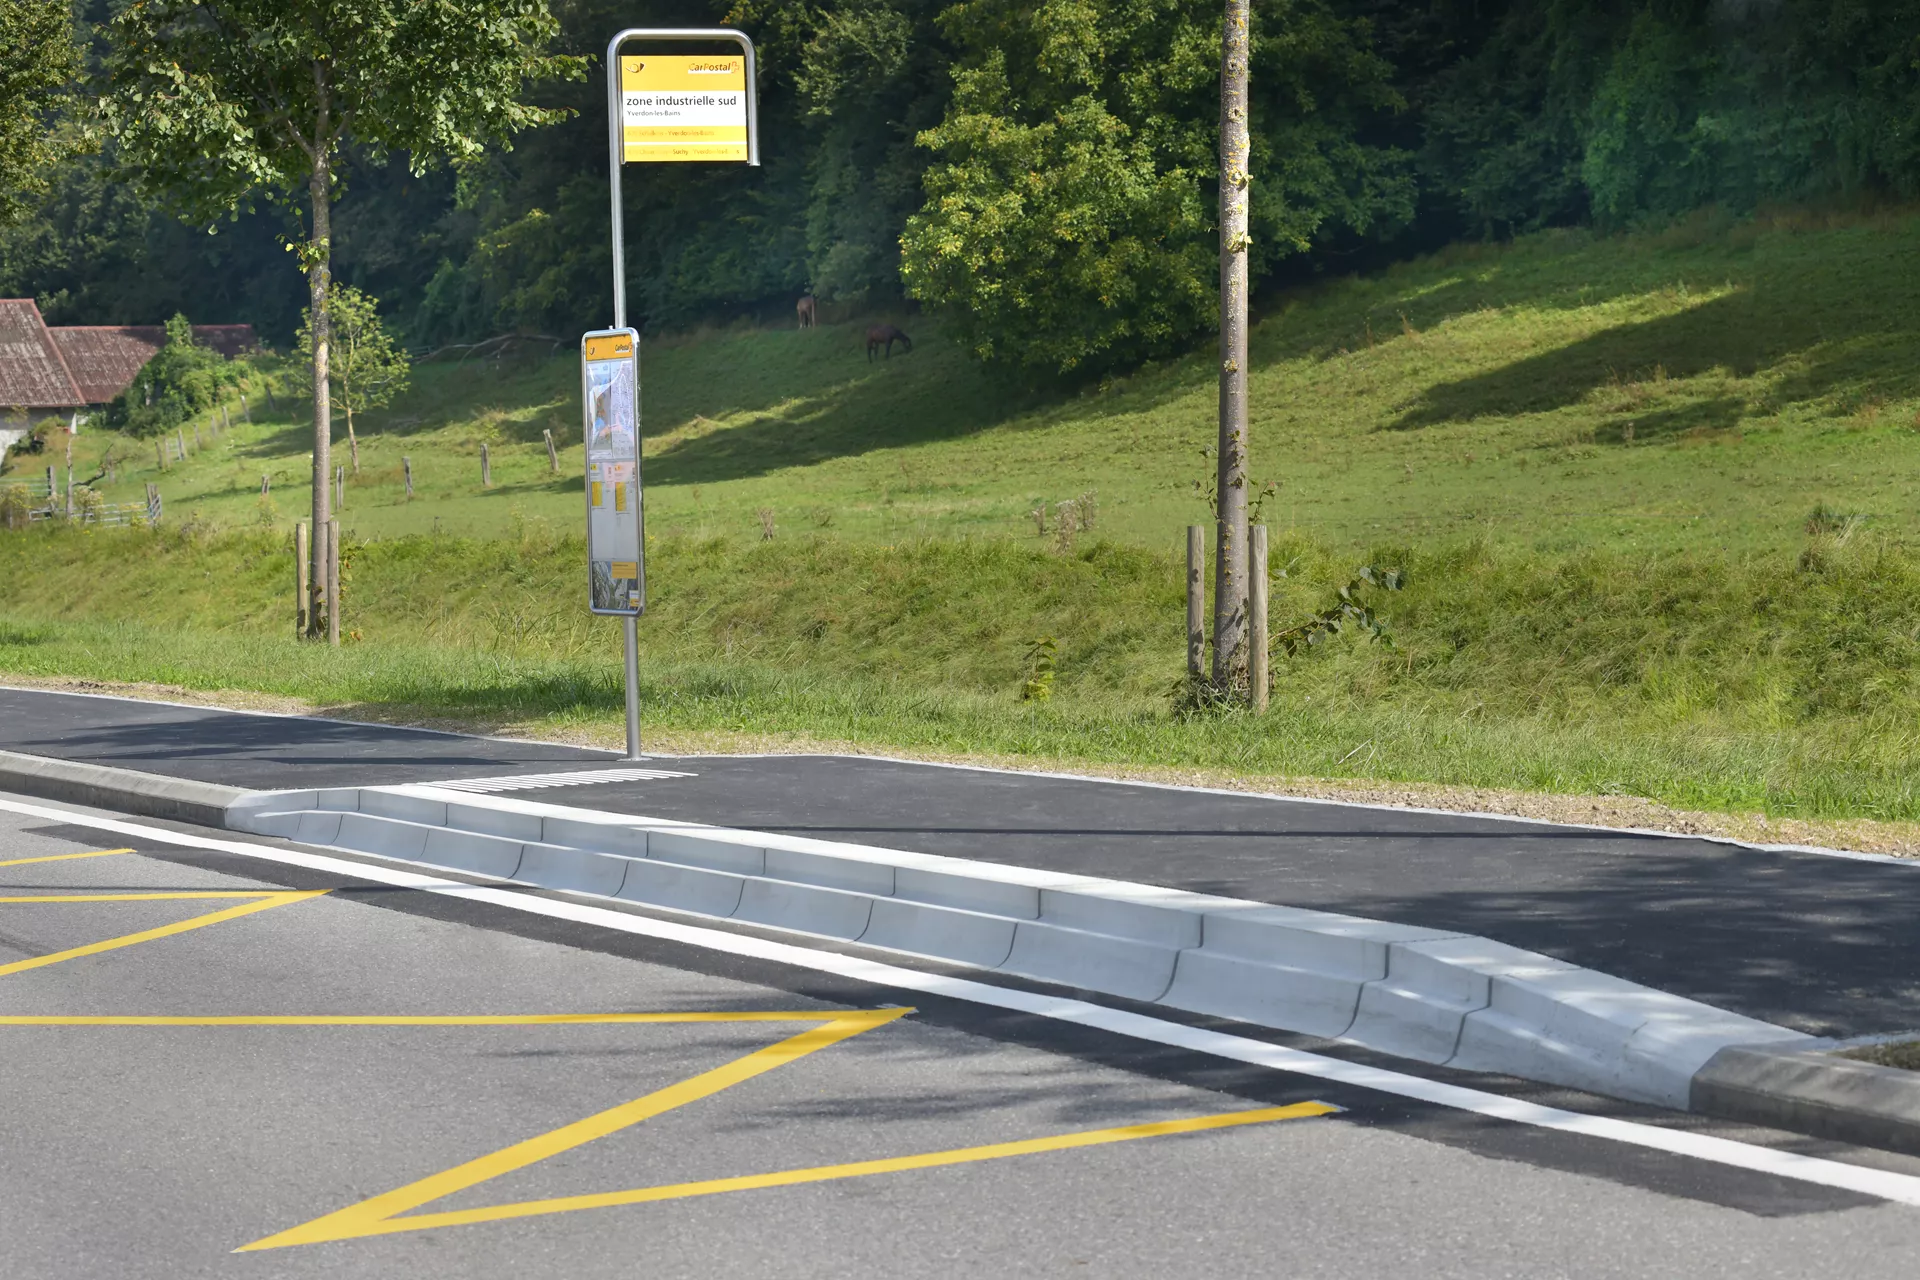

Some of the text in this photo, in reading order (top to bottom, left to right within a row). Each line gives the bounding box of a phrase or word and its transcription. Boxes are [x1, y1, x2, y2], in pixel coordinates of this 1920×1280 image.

[689, 62, 731, 72] CarPostal
[627, 95, 737, 106] zone industrielle sud
[672, 148, 689, 156] Suchy
